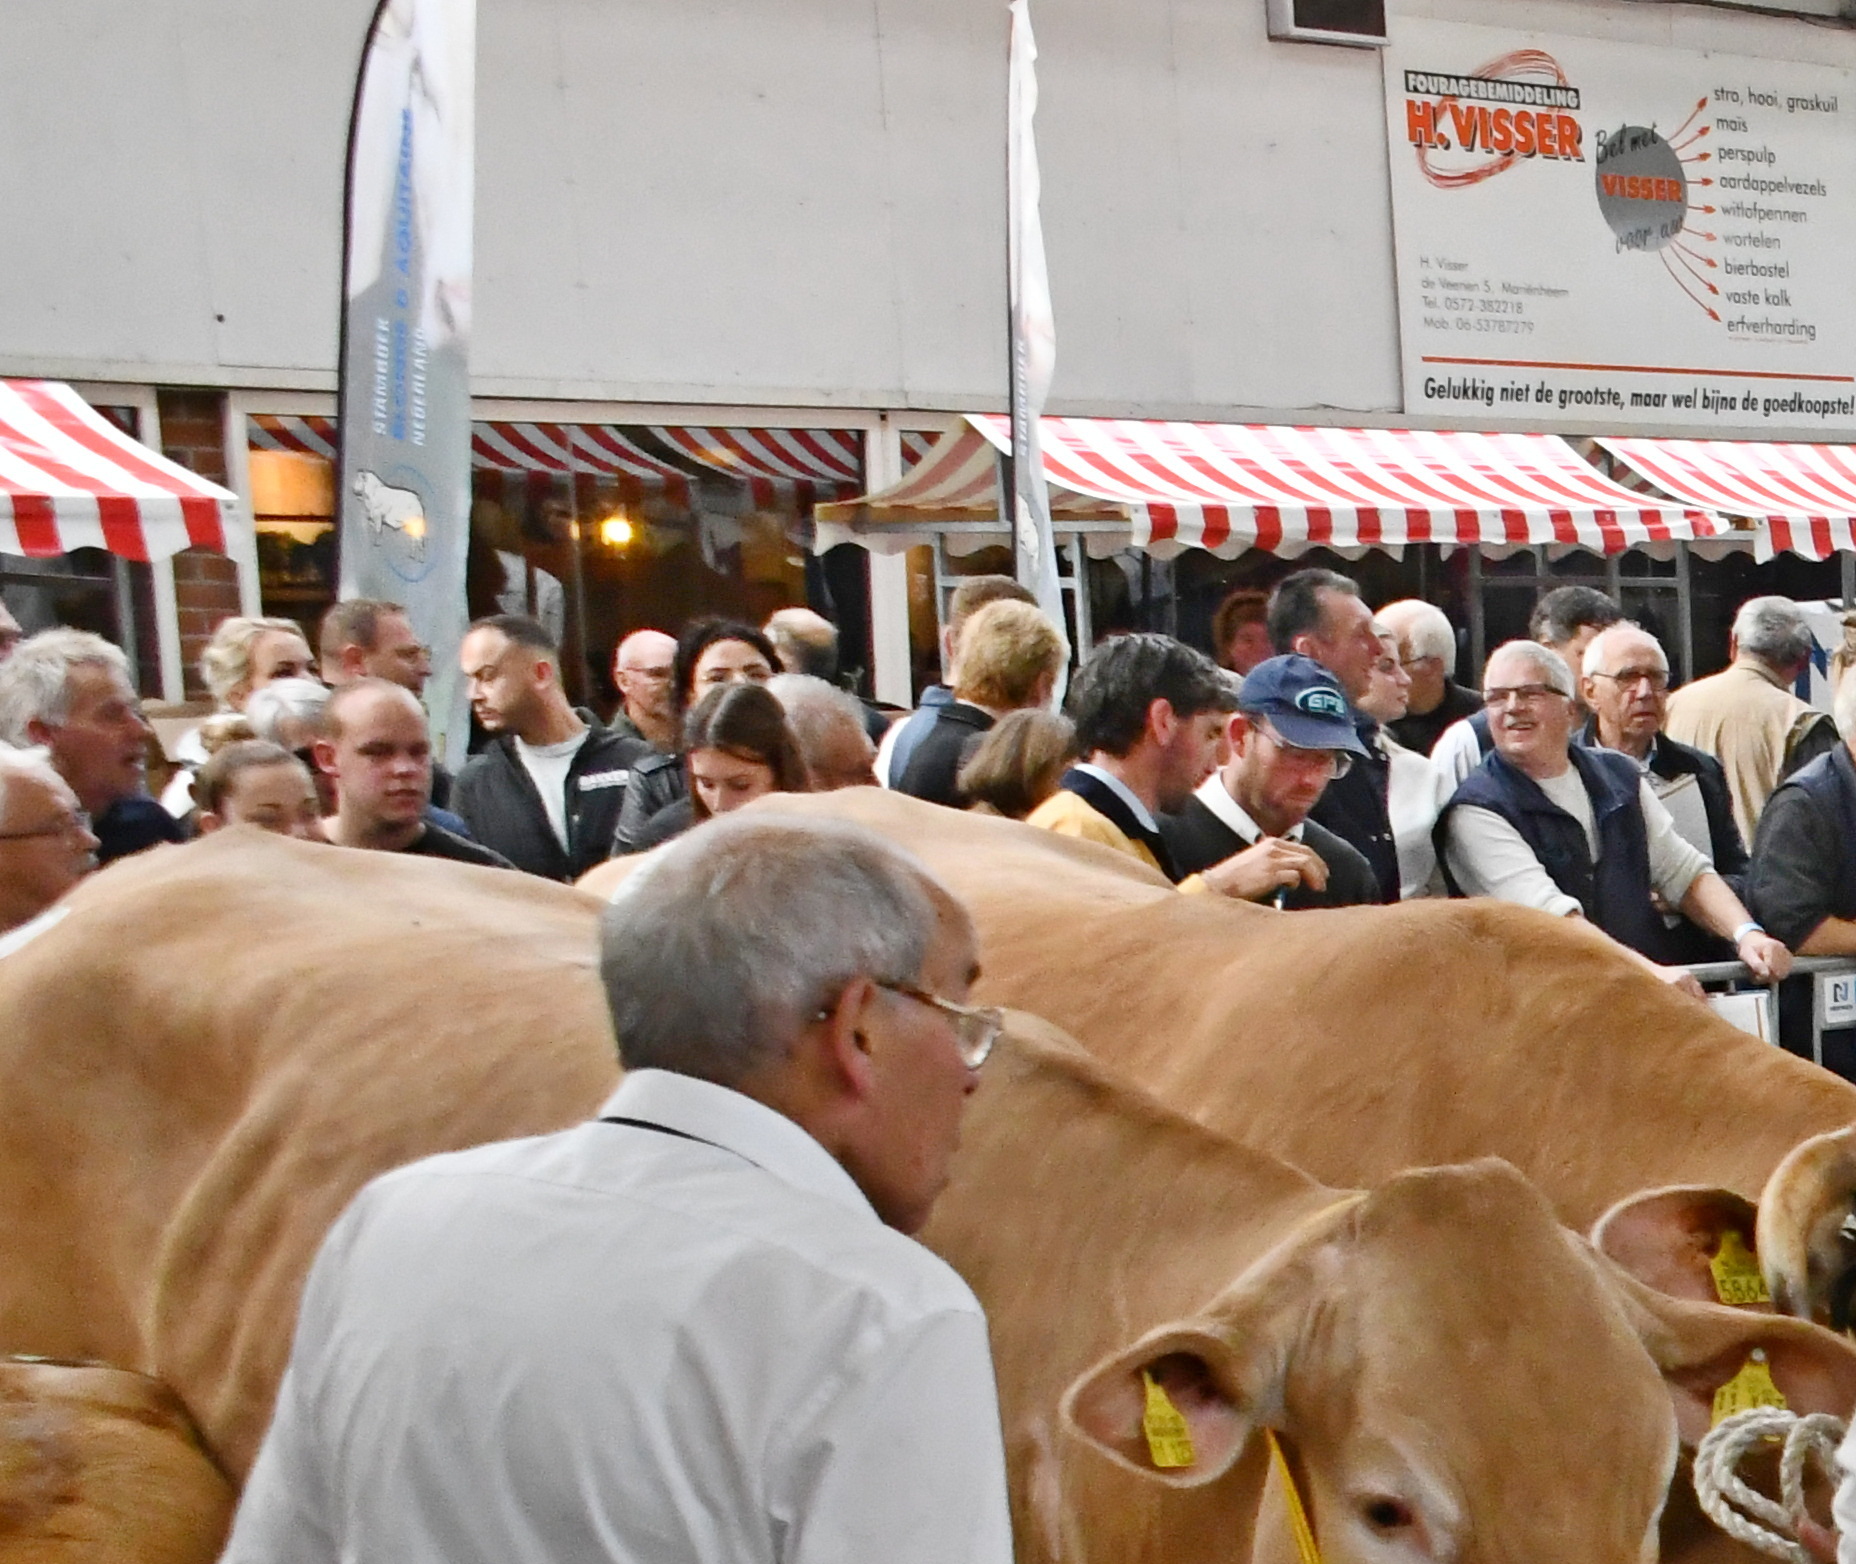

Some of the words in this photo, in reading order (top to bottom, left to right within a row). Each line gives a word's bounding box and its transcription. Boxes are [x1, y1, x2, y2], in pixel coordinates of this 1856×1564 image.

[1407, 73, 1578, 109] FOURAGEBEMIDDELING
[1714, 87, 1744, 107] stro,
[1787, 93, 1839, 113] graskuil
[1718, 145, 1777, 168] perspulp
[1601, 173, 1682, 202] VISSER
[1720, 172, 1827, 197] aardappelvezels
[1721, 201, 1807, 224] witlofpennen
[1722, 231, 1781, 249] wortelen
[1724, 256, 1790, 279] bierbostel
[1725, 289, 1760, 305] vaste
[1764, 287, 1792, 307] kalk
[1727, 315, 1817, 340] erfverharding
[410, 326, 428, 446] NEDERLAND
[1424, 377, 1494, 407] Gelukkig
[1500, 380, 1531, 404] niet
[1535, 381, 1553, 404] de
[1558, 386, 1625, 411] grootste,
[1630, 390, 1667, 409] maar
[1672, 387, 1698, 410] wel
[1701, 388, 1737, 415] bijna
[1741, 390, 1759, 413] de
[1763, 391, 1856, 419] goedkoopste!
